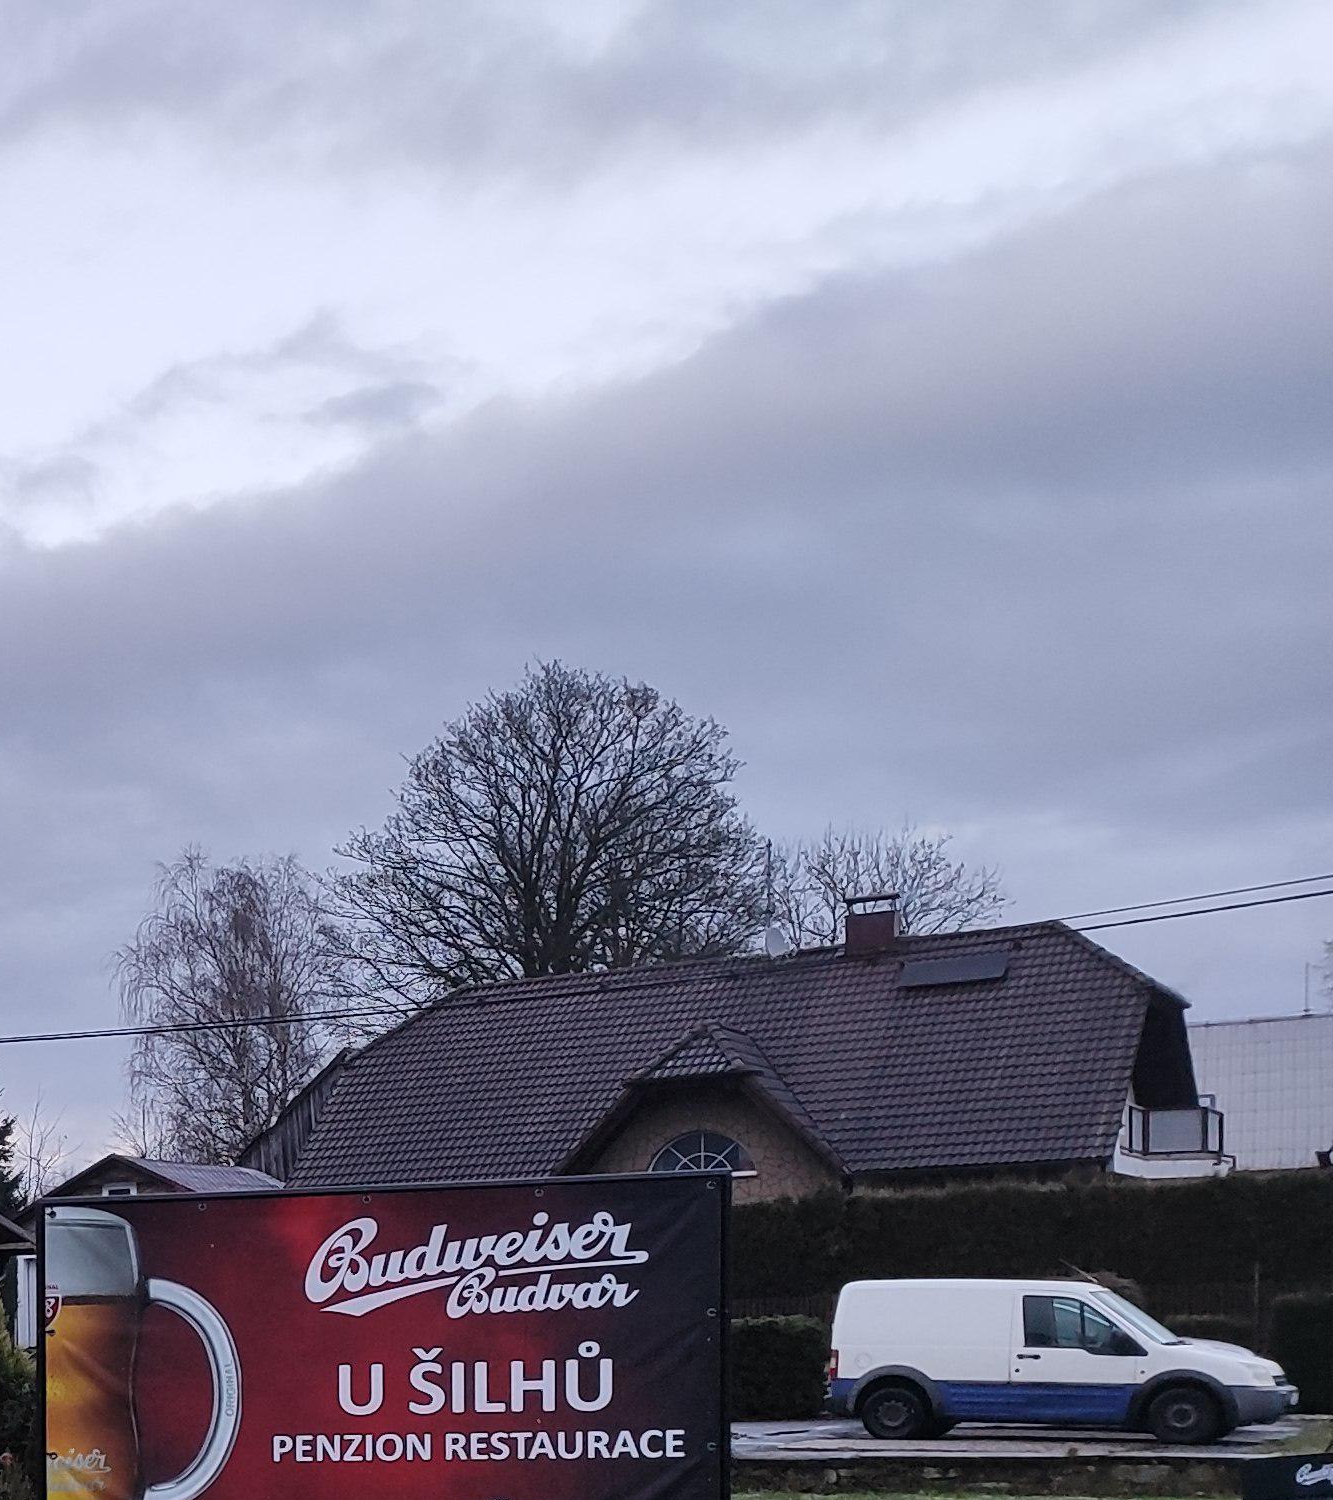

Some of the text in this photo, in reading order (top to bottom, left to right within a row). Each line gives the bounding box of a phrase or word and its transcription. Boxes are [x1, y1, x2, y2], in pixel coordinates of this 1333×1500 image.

[305, 1211, 649, 1304] Budweiser
[446, 1265, 639, 1319] Budvar
[338, 1340, 614, 1416] U ŠILHŮ
[272, 1429, 686, 1463] PENZION RESTAURACE
